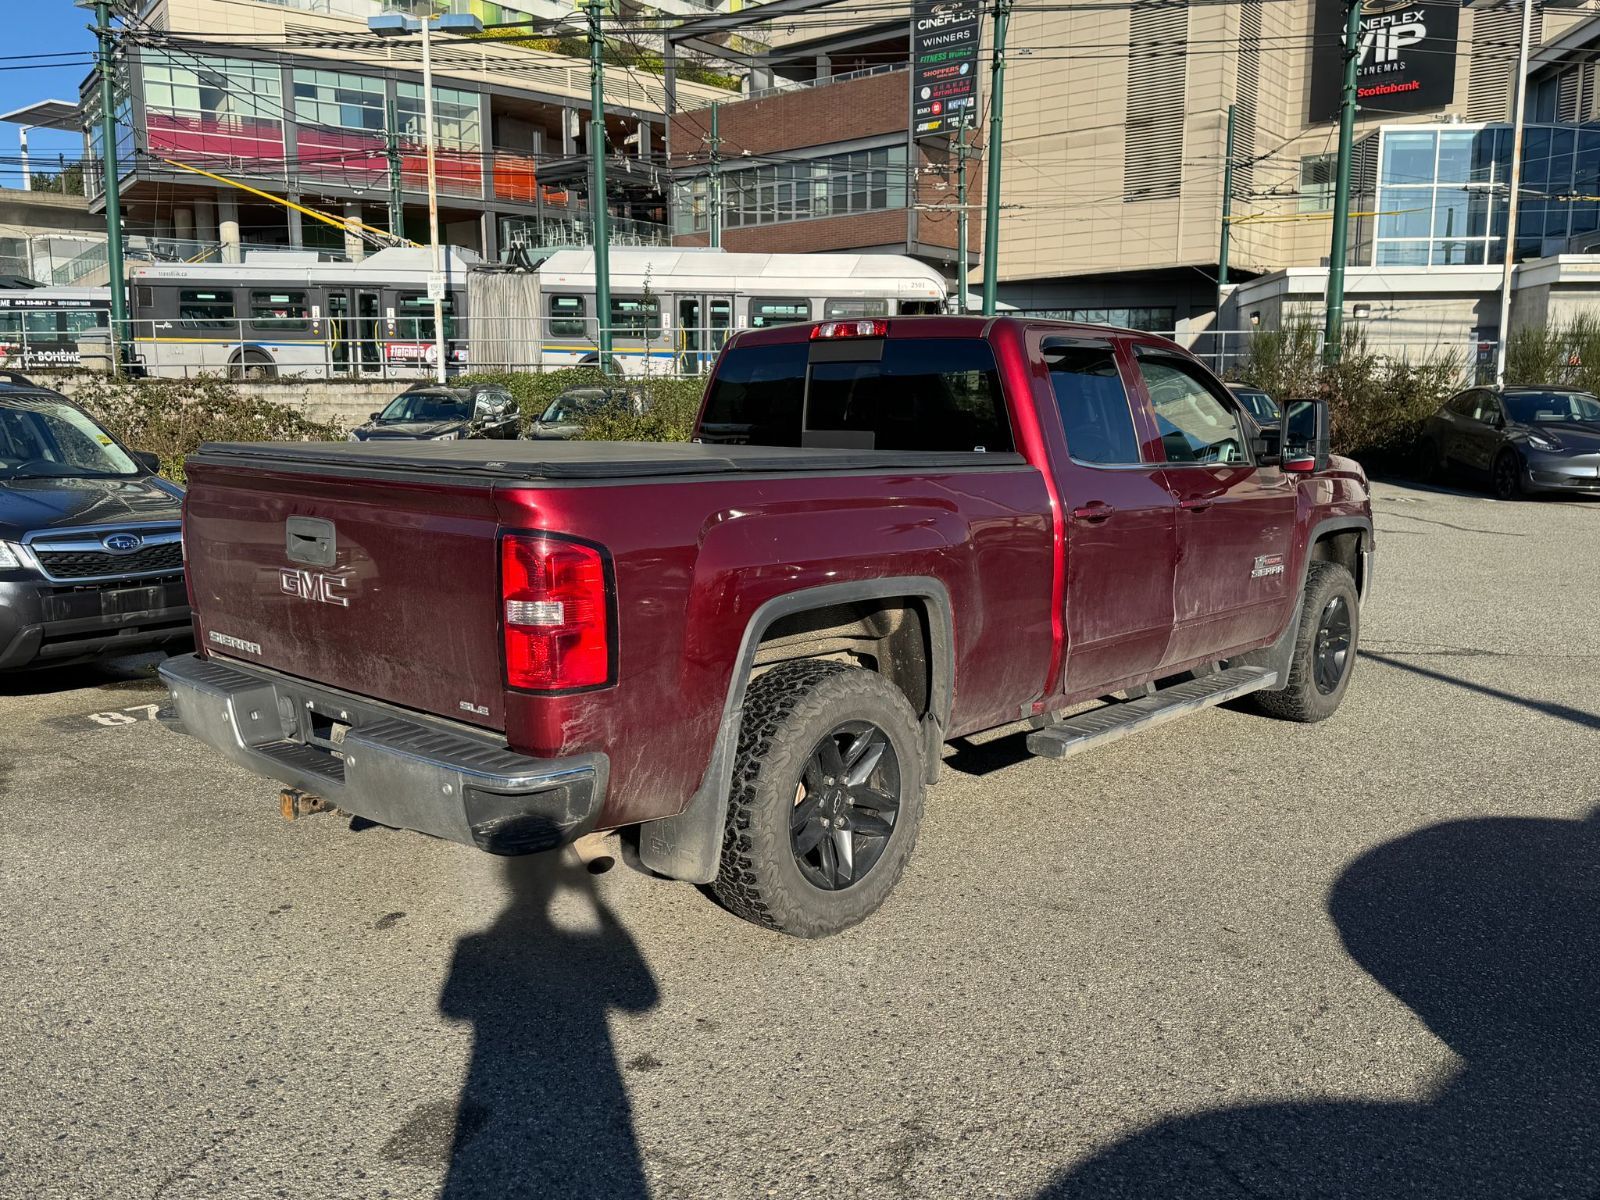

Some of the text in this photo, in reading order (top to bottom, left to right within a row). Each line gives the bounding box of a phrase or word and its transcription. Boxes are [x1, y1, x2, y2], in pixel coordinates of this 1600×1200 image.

[917, 9, 976, 30] CINEPLEX
[922, 30, 970, 47] WINNERS
[1341, 22, 1427, 66] VIP
[920, 51, 947, 63] FITNESS
[922, 65, 960, 78] SHOPPERS
[1356, 62, 1406, 76] CINEMAS
[1357, 80, 1420, 97] Scotiabank
[38, 349, 80, 362] BOHÈME
[1251, 565, 1284, 578] SIERRA
[279, 567, 349, 606] GMC
[209, 630, 262, 655] SIERRA
